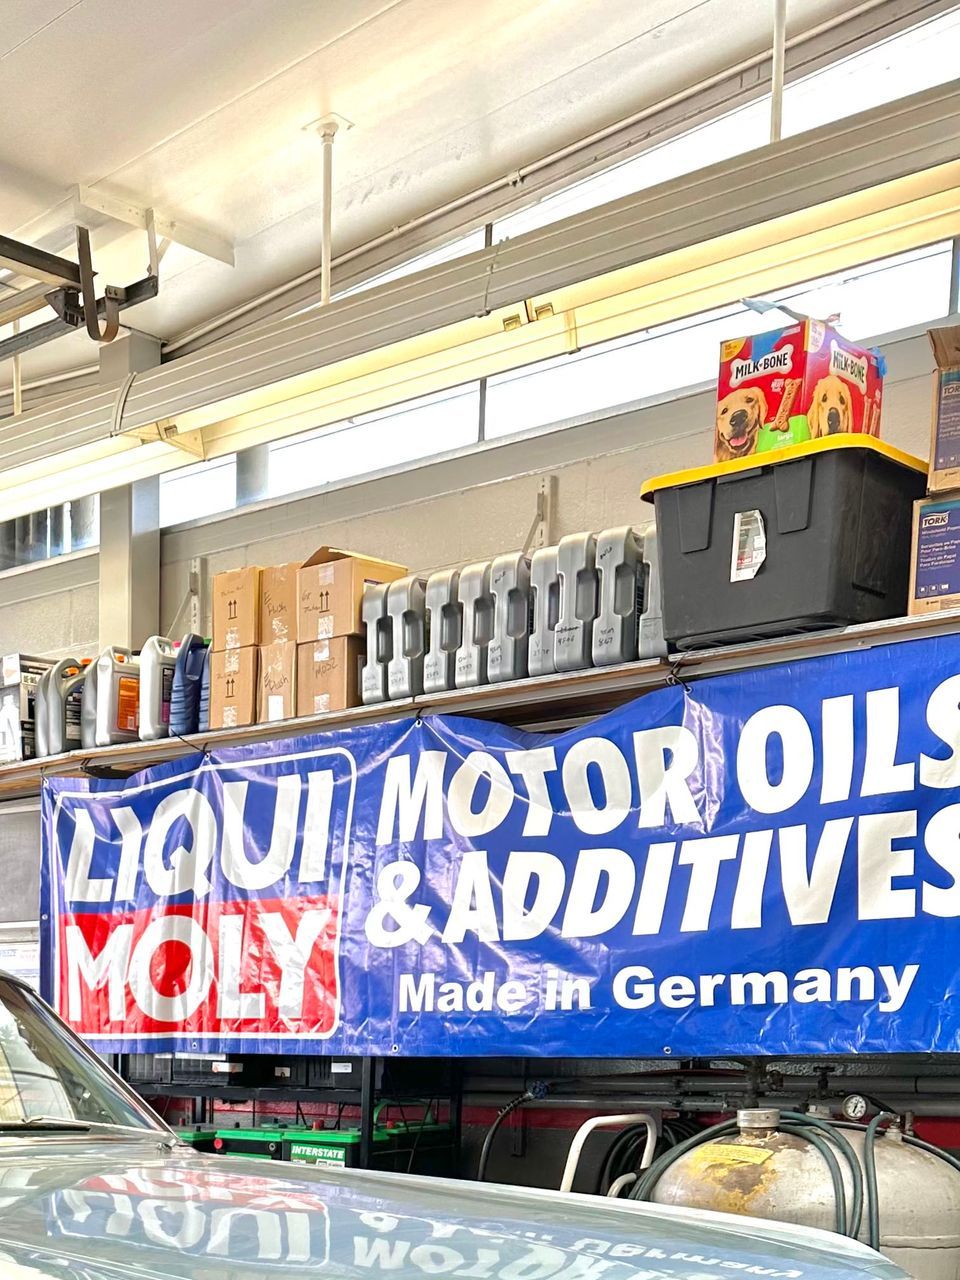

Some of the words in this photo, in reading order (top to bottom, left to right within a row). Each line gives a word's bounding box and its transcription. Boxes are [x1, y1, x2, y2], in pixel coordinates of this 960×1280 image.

[923, 515, 947, 527] TORK
[376, 726, 703, 846] MOTOR
[736, 673, 960, 815] OILS
[65, 770, 334, 902] LIQUI
[66, 909, 332, 1023] MOLY
[399, 970, 527, 1013] Made
[545, 968, 592, 1011] in
[612, 964, 920, 1013] Germany
[291, 1145, 345, 1159] INTERSTATE
